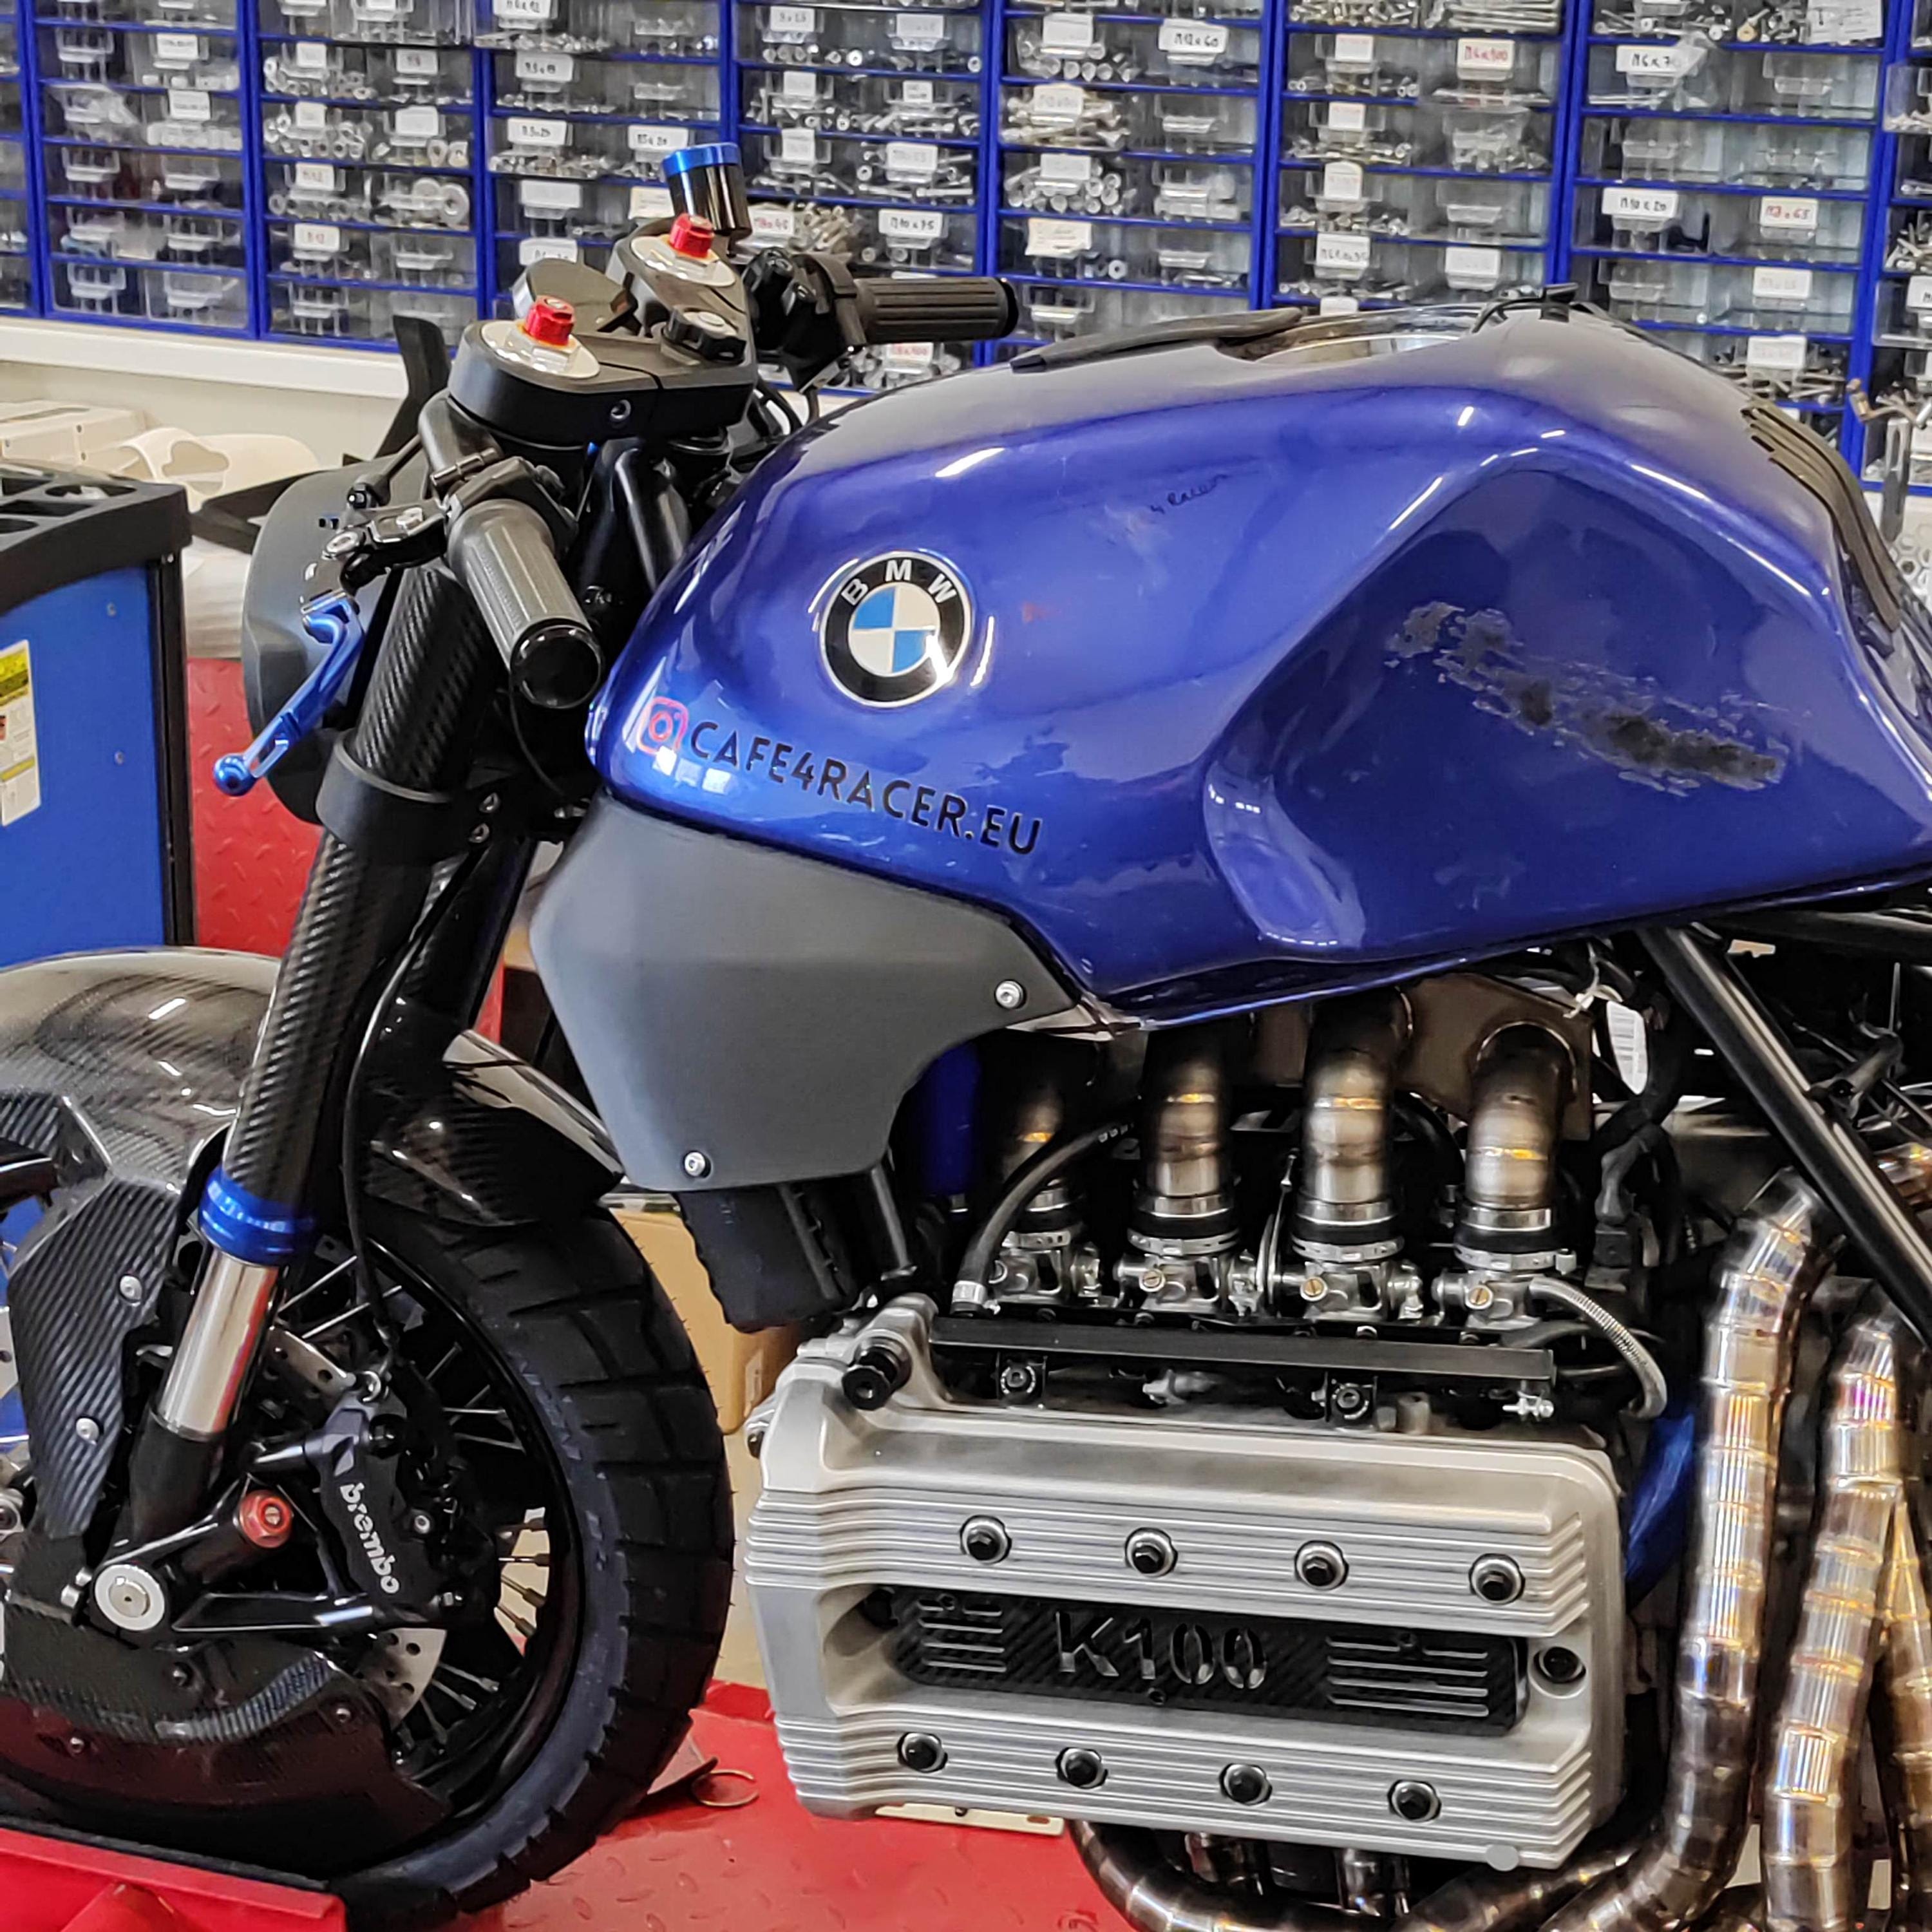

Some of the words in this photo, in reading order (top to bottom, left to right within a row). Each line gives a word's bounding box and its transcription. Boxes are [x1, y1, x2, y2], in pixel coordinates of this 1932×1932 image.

[840, 558, 958, 607] BMW
[690, 719, 1043, 855] CAFE4RACER.EU
[339, 1482, 400, 1594] brembo
[1052, 1611, 1268, 1690] K100
